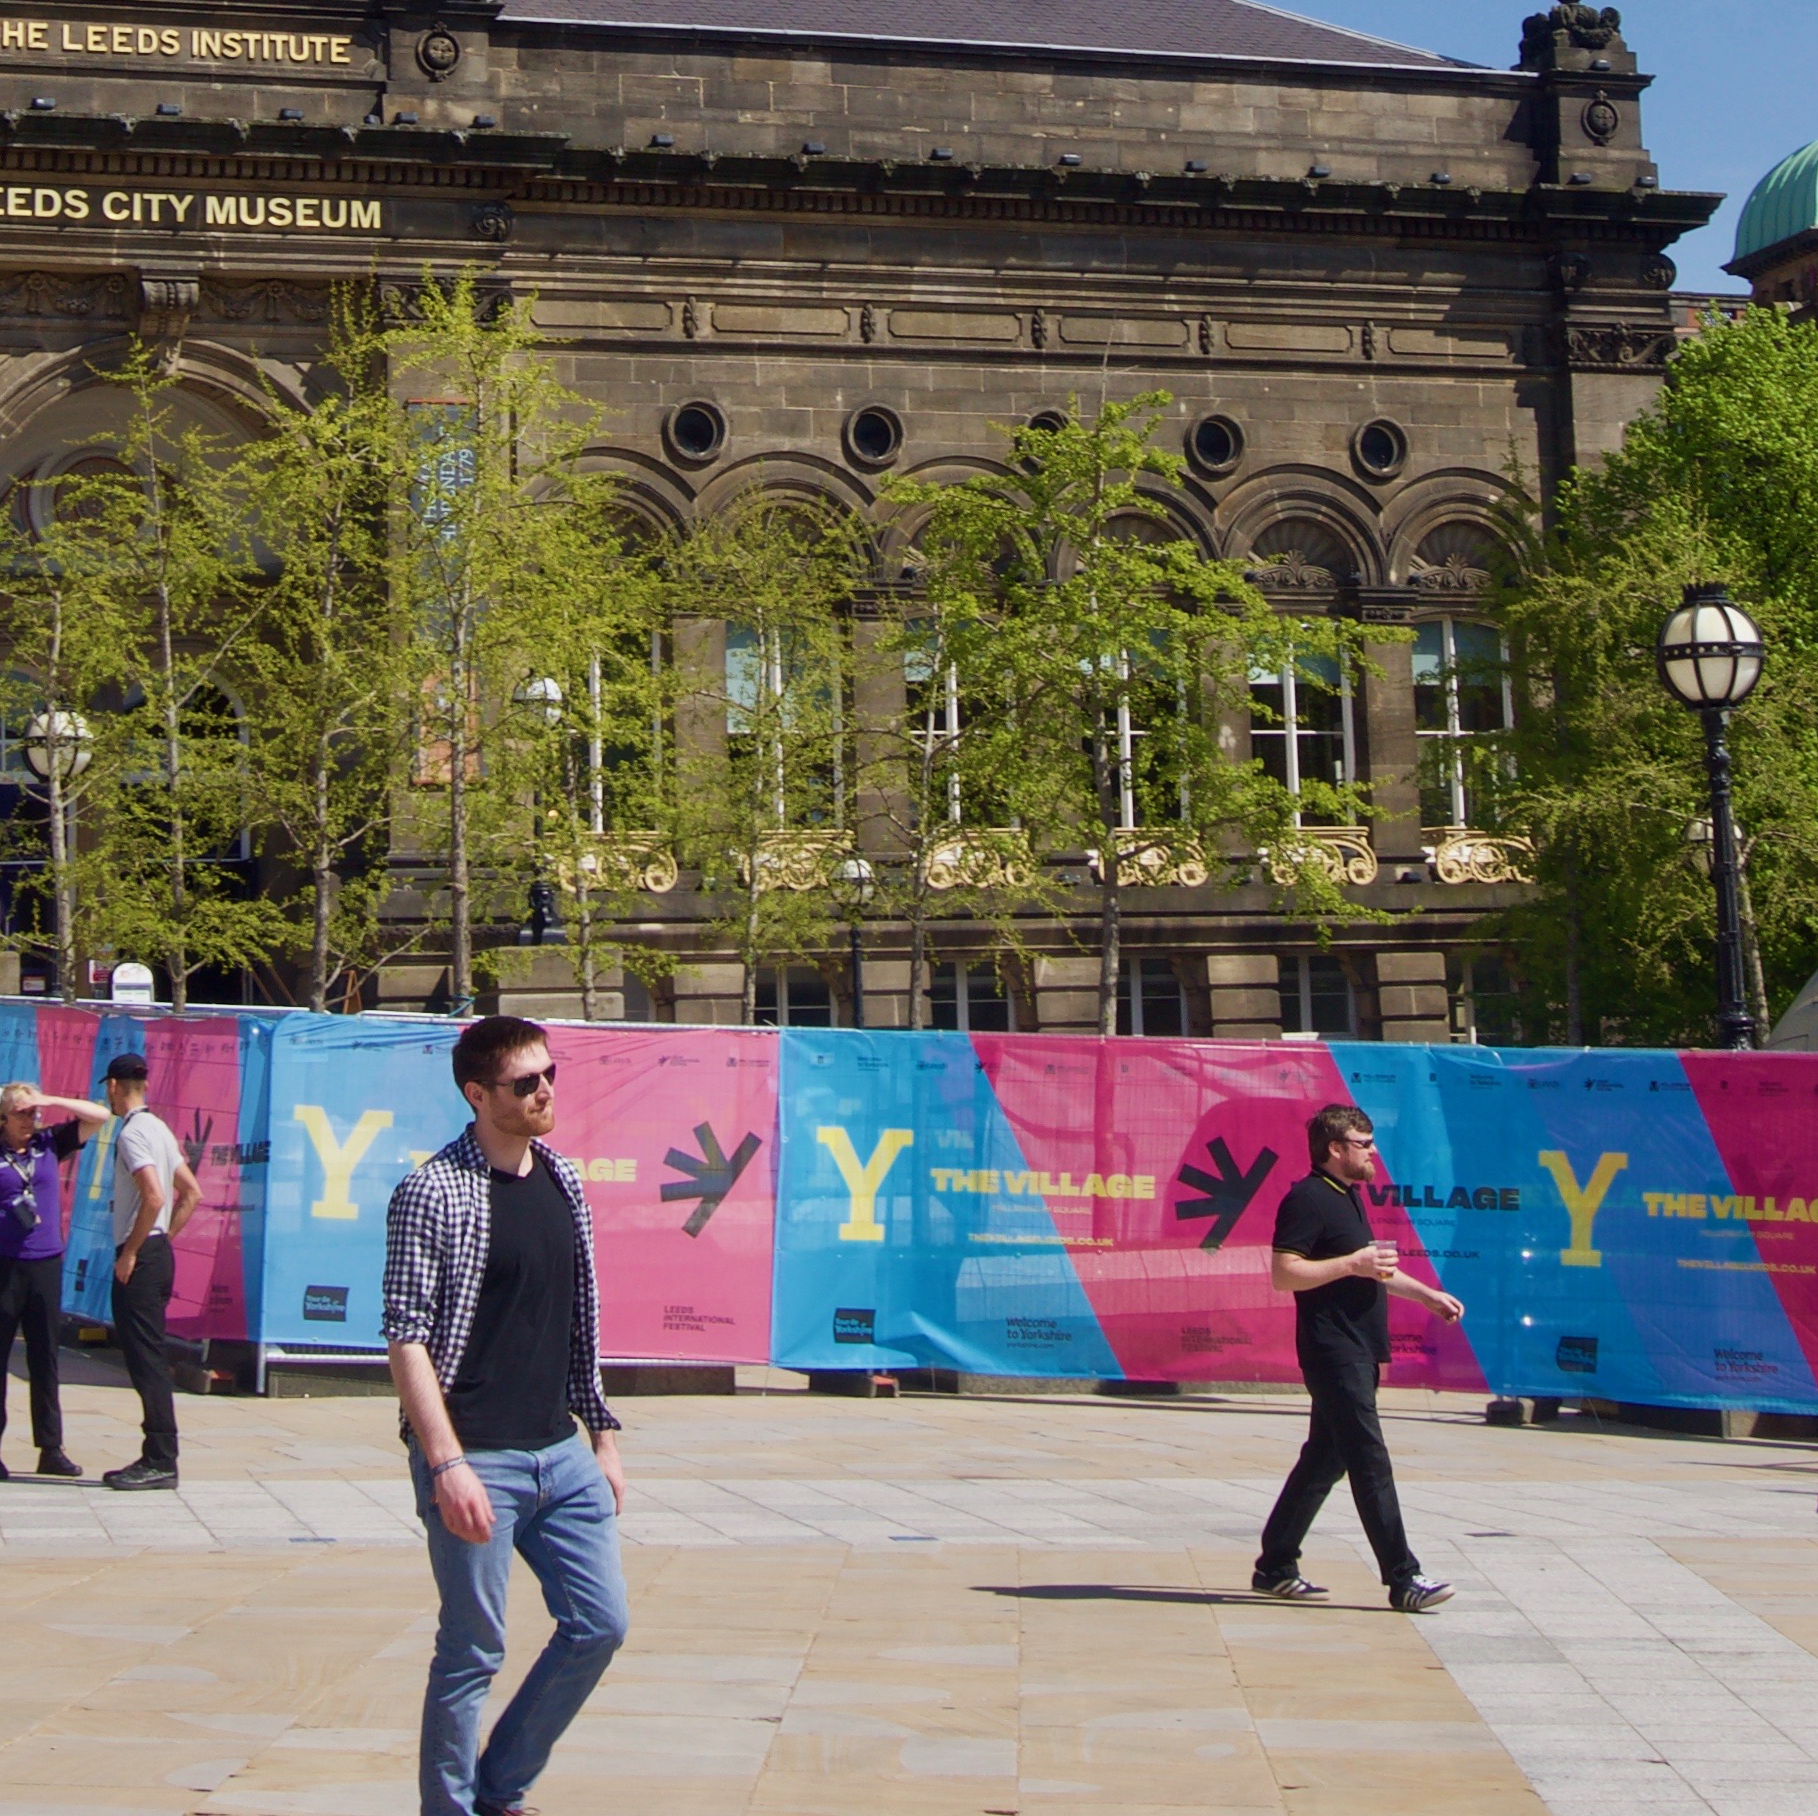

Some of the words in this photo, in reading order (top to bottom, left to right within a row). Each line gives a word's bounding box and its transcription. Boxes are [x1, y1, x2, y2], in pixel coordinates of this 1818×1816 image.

[61, 23, 181, 56] LEEDS
[190, 29, 352, 65] INSTITUTE
[103, 191, 194, 224] CITY
[205, 196, 382, 230] MUSEUM
[293, 1104, 394, 1220] Y
[816, 1126, 914, 1242] Y
[930, 1167, 999, 1194] THE
[1004, 1171, 1156, 1199] VILLAGE
[1367, 1185, 1520, 1211] VILLAGE
[1643, 1192, 1707, 1218] THE
[1538, 1150, 1628, 1268] Y
[664, 1306, 694, 1314] LEEDS
[663, 1315, 735, 1325] INTERNATIONAL
[663, 1323, 705, 1332] FESTIVAL
[1006, 1316, 1058, 1329] Welcome
[1006, 1329, 1019, 1339] to
[1020, 1329, 1072, 1342] Yorkshire
[1391, 1344, 1436, 1355] orkshire
[1713, 1348, 1764, 1361] Welcome
[1715, 1362, 1727, 1372] to
[1730, 1362, 1779, 1374] Yorkshire
